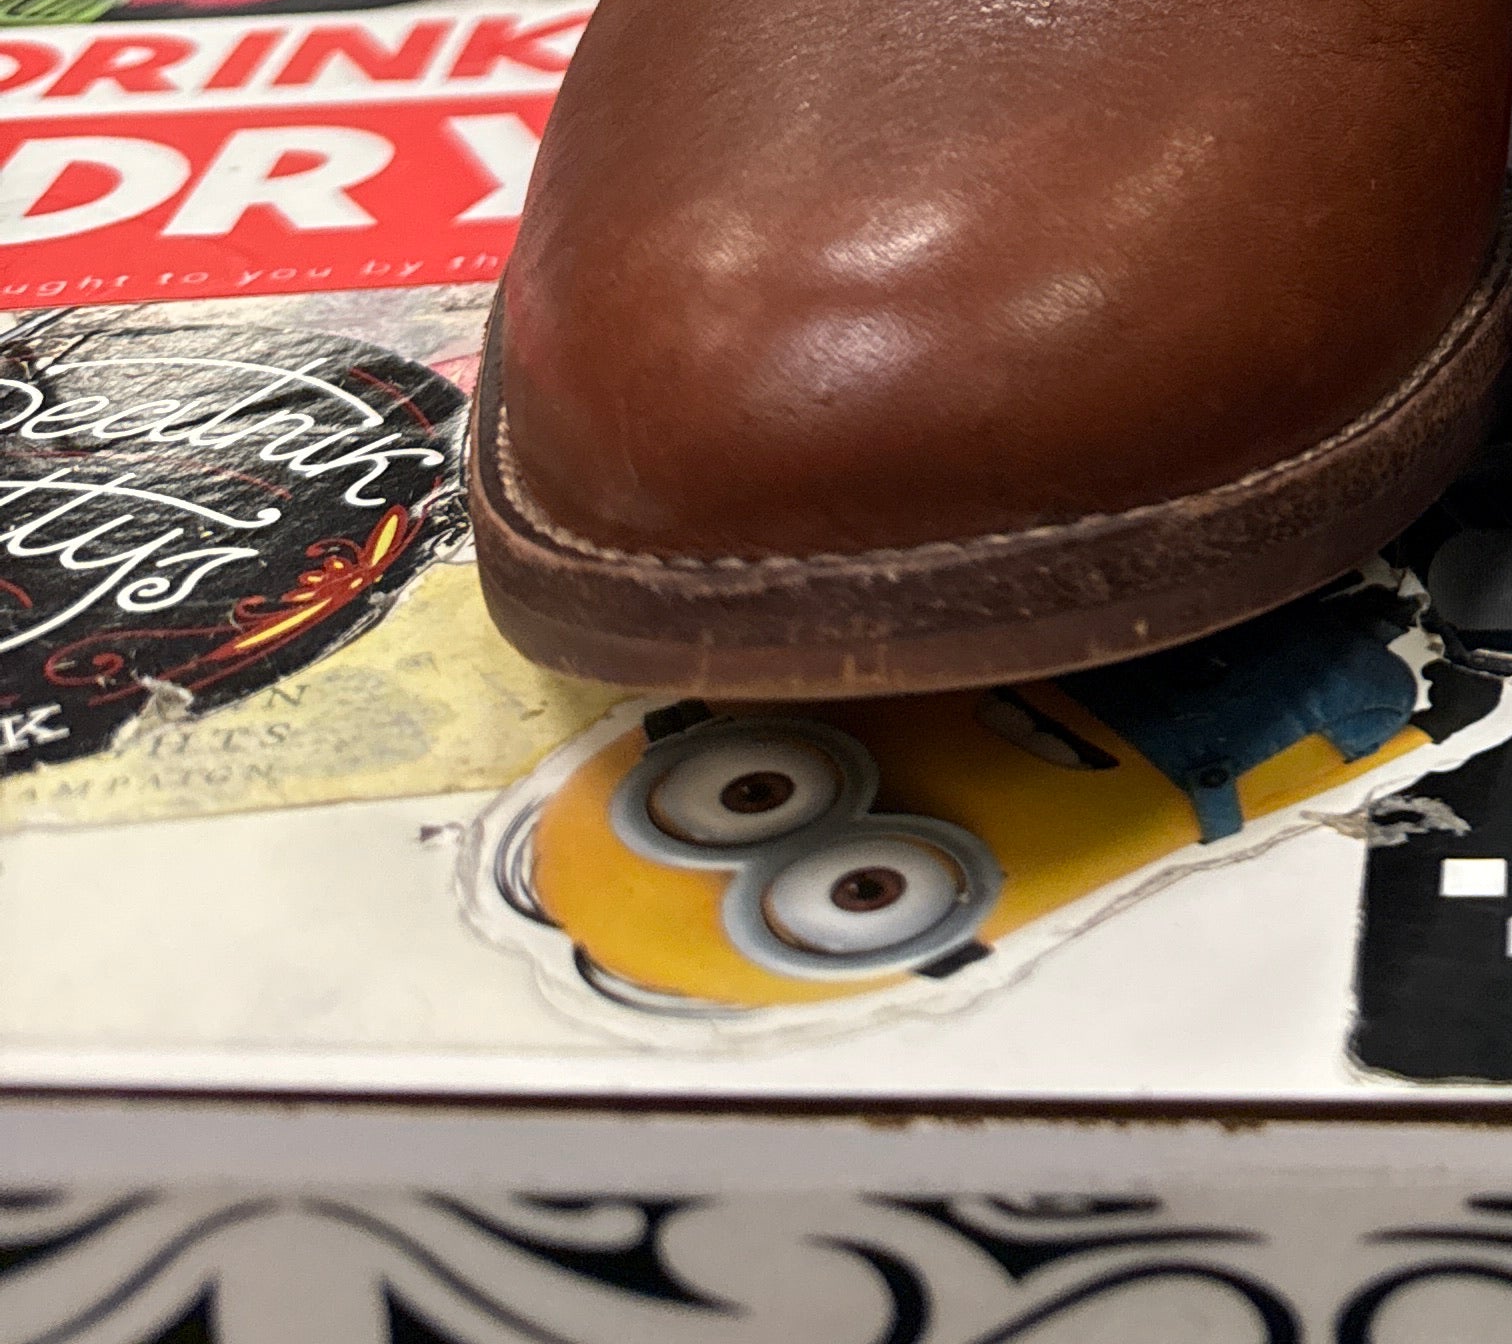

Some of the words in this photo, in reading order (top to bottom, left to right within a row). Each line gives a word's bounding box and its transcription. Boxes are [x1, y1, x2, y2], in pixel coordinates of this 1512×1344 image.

[157, 270, 210, 286] to
[235, 265, 333, 288] you
[359, 258, 425, 279] by
